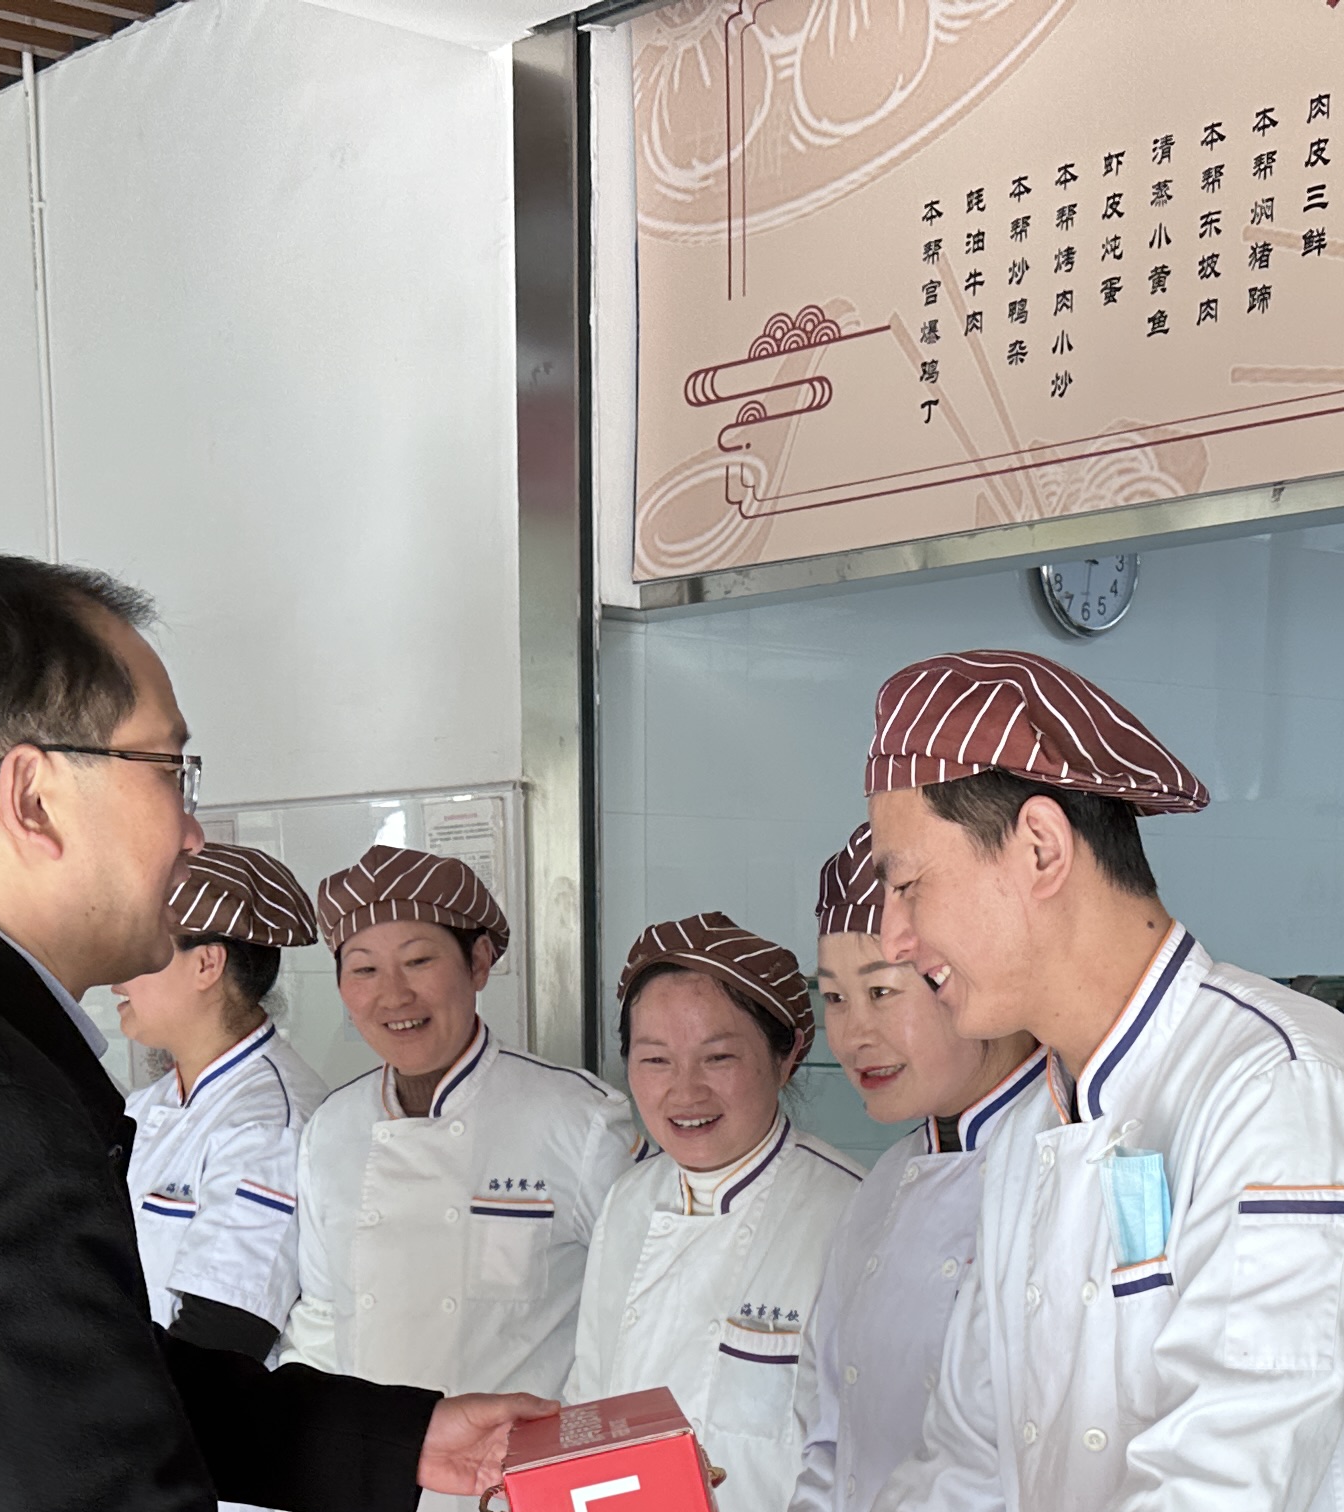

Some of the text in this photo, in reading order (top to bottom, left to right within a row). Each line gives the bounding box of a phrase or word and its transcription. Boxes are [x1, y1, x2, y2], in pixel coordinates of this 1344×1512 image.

[1100, 150, 1126, 306] 虾皮炖蛋
[1146, 134, 1176, 338] 清蒸小黄鱼
[1196, 122, 1226, 326] 本帮东坡肉
[1246, 107, 1279, 314] 本帮焖猪蹄
[1301, 93, 1331, 257] 肉皮三鲜
[920, 200, 943, 424] 本帮宫爆鸡丁
[964, 187, 986, 337] 蚝油牛肉
[1007, 175, 1032, 365] 本帮炒鸭杂
[1051, 163, 1079, 398] 本帮烤肉小炒
[1054, 573, 1063, 592] 8
[1064, 594, 1074, 612] 7
[1081, 602, 1090, 621] 6
[1097, 596, 1106, 615] 5
[1109, 579, 1118, 597] 4
[1115, 554, 1124, 572] 3
[489, 1177, 547, 1192] 海事餐饮
[740, 1302, 799, 1322] 海事餐饮
